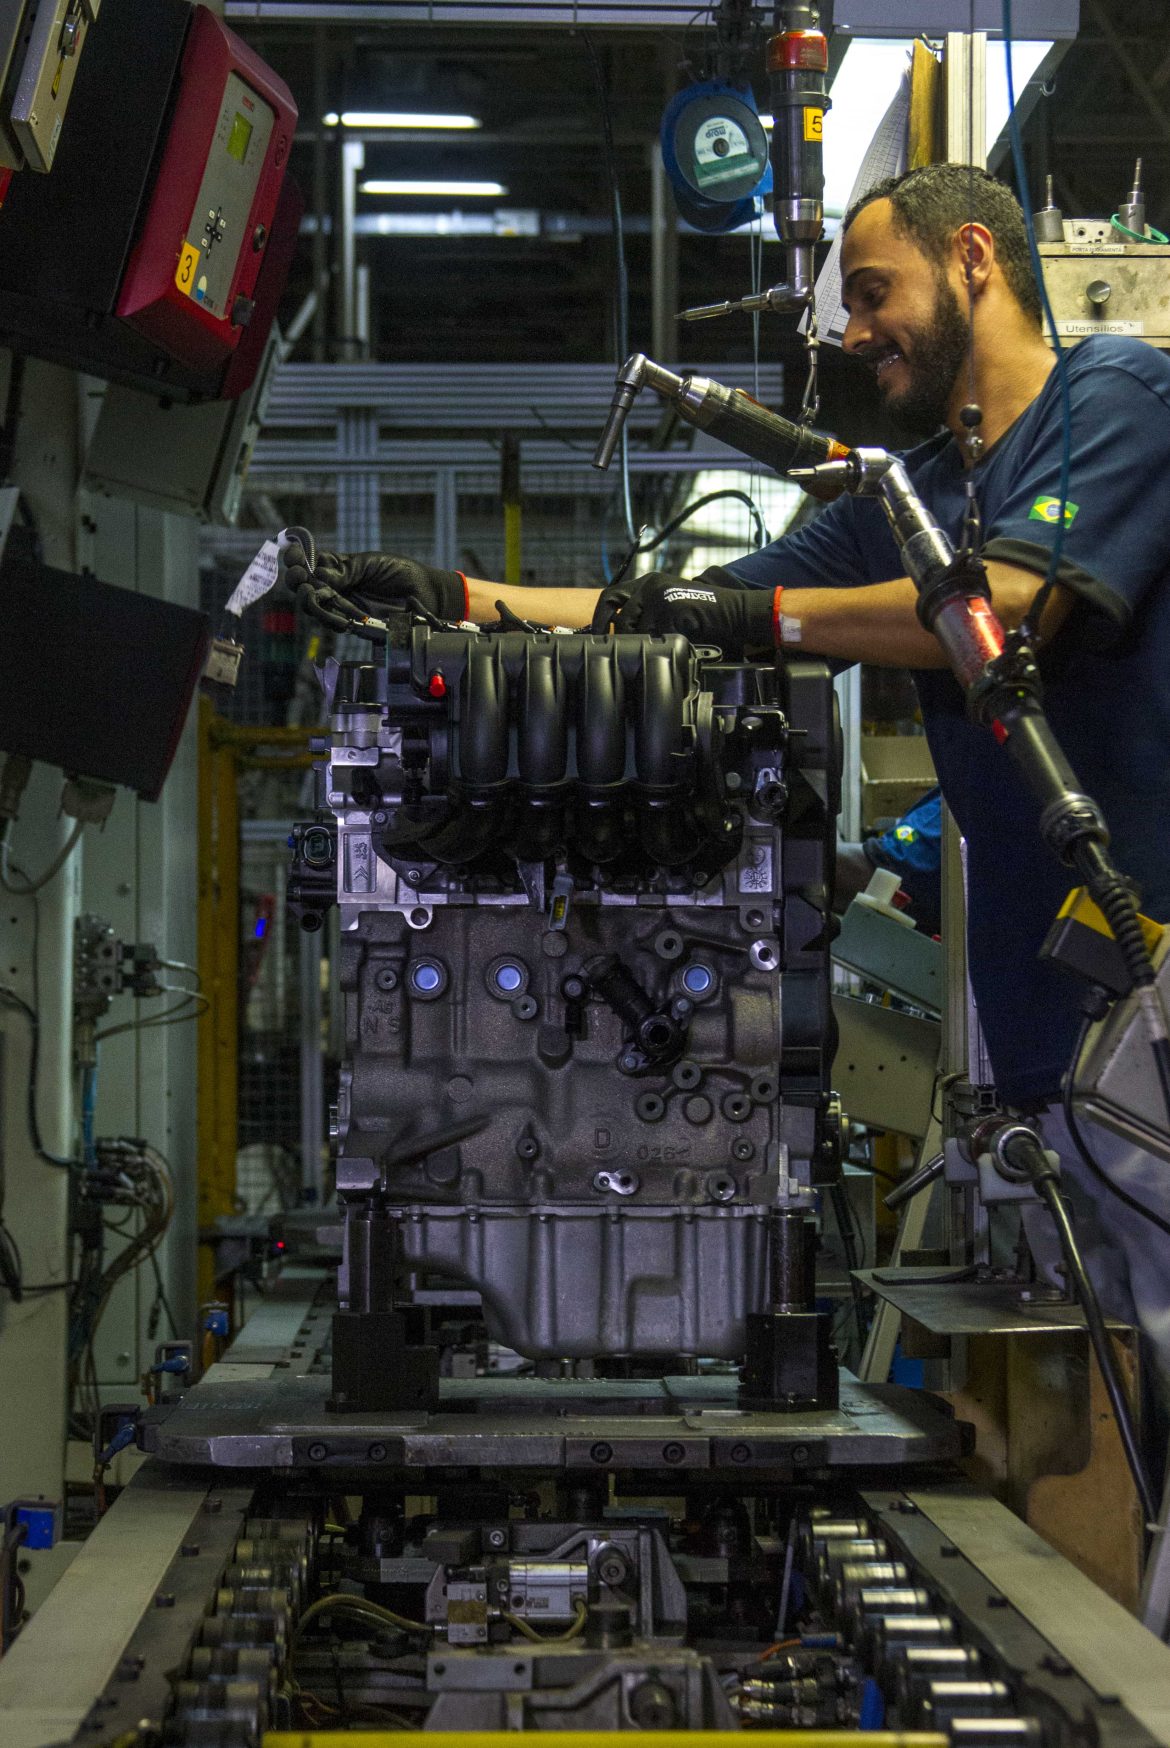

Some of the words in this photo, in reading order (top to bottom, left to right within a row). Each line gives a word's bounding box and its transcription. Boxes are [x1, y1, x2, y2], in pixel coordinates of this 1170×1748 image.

[812, 115, 823, 134] 5
[181, 254, 193, 283] 3
[1065, 324, 1124, 333] Utensilios
